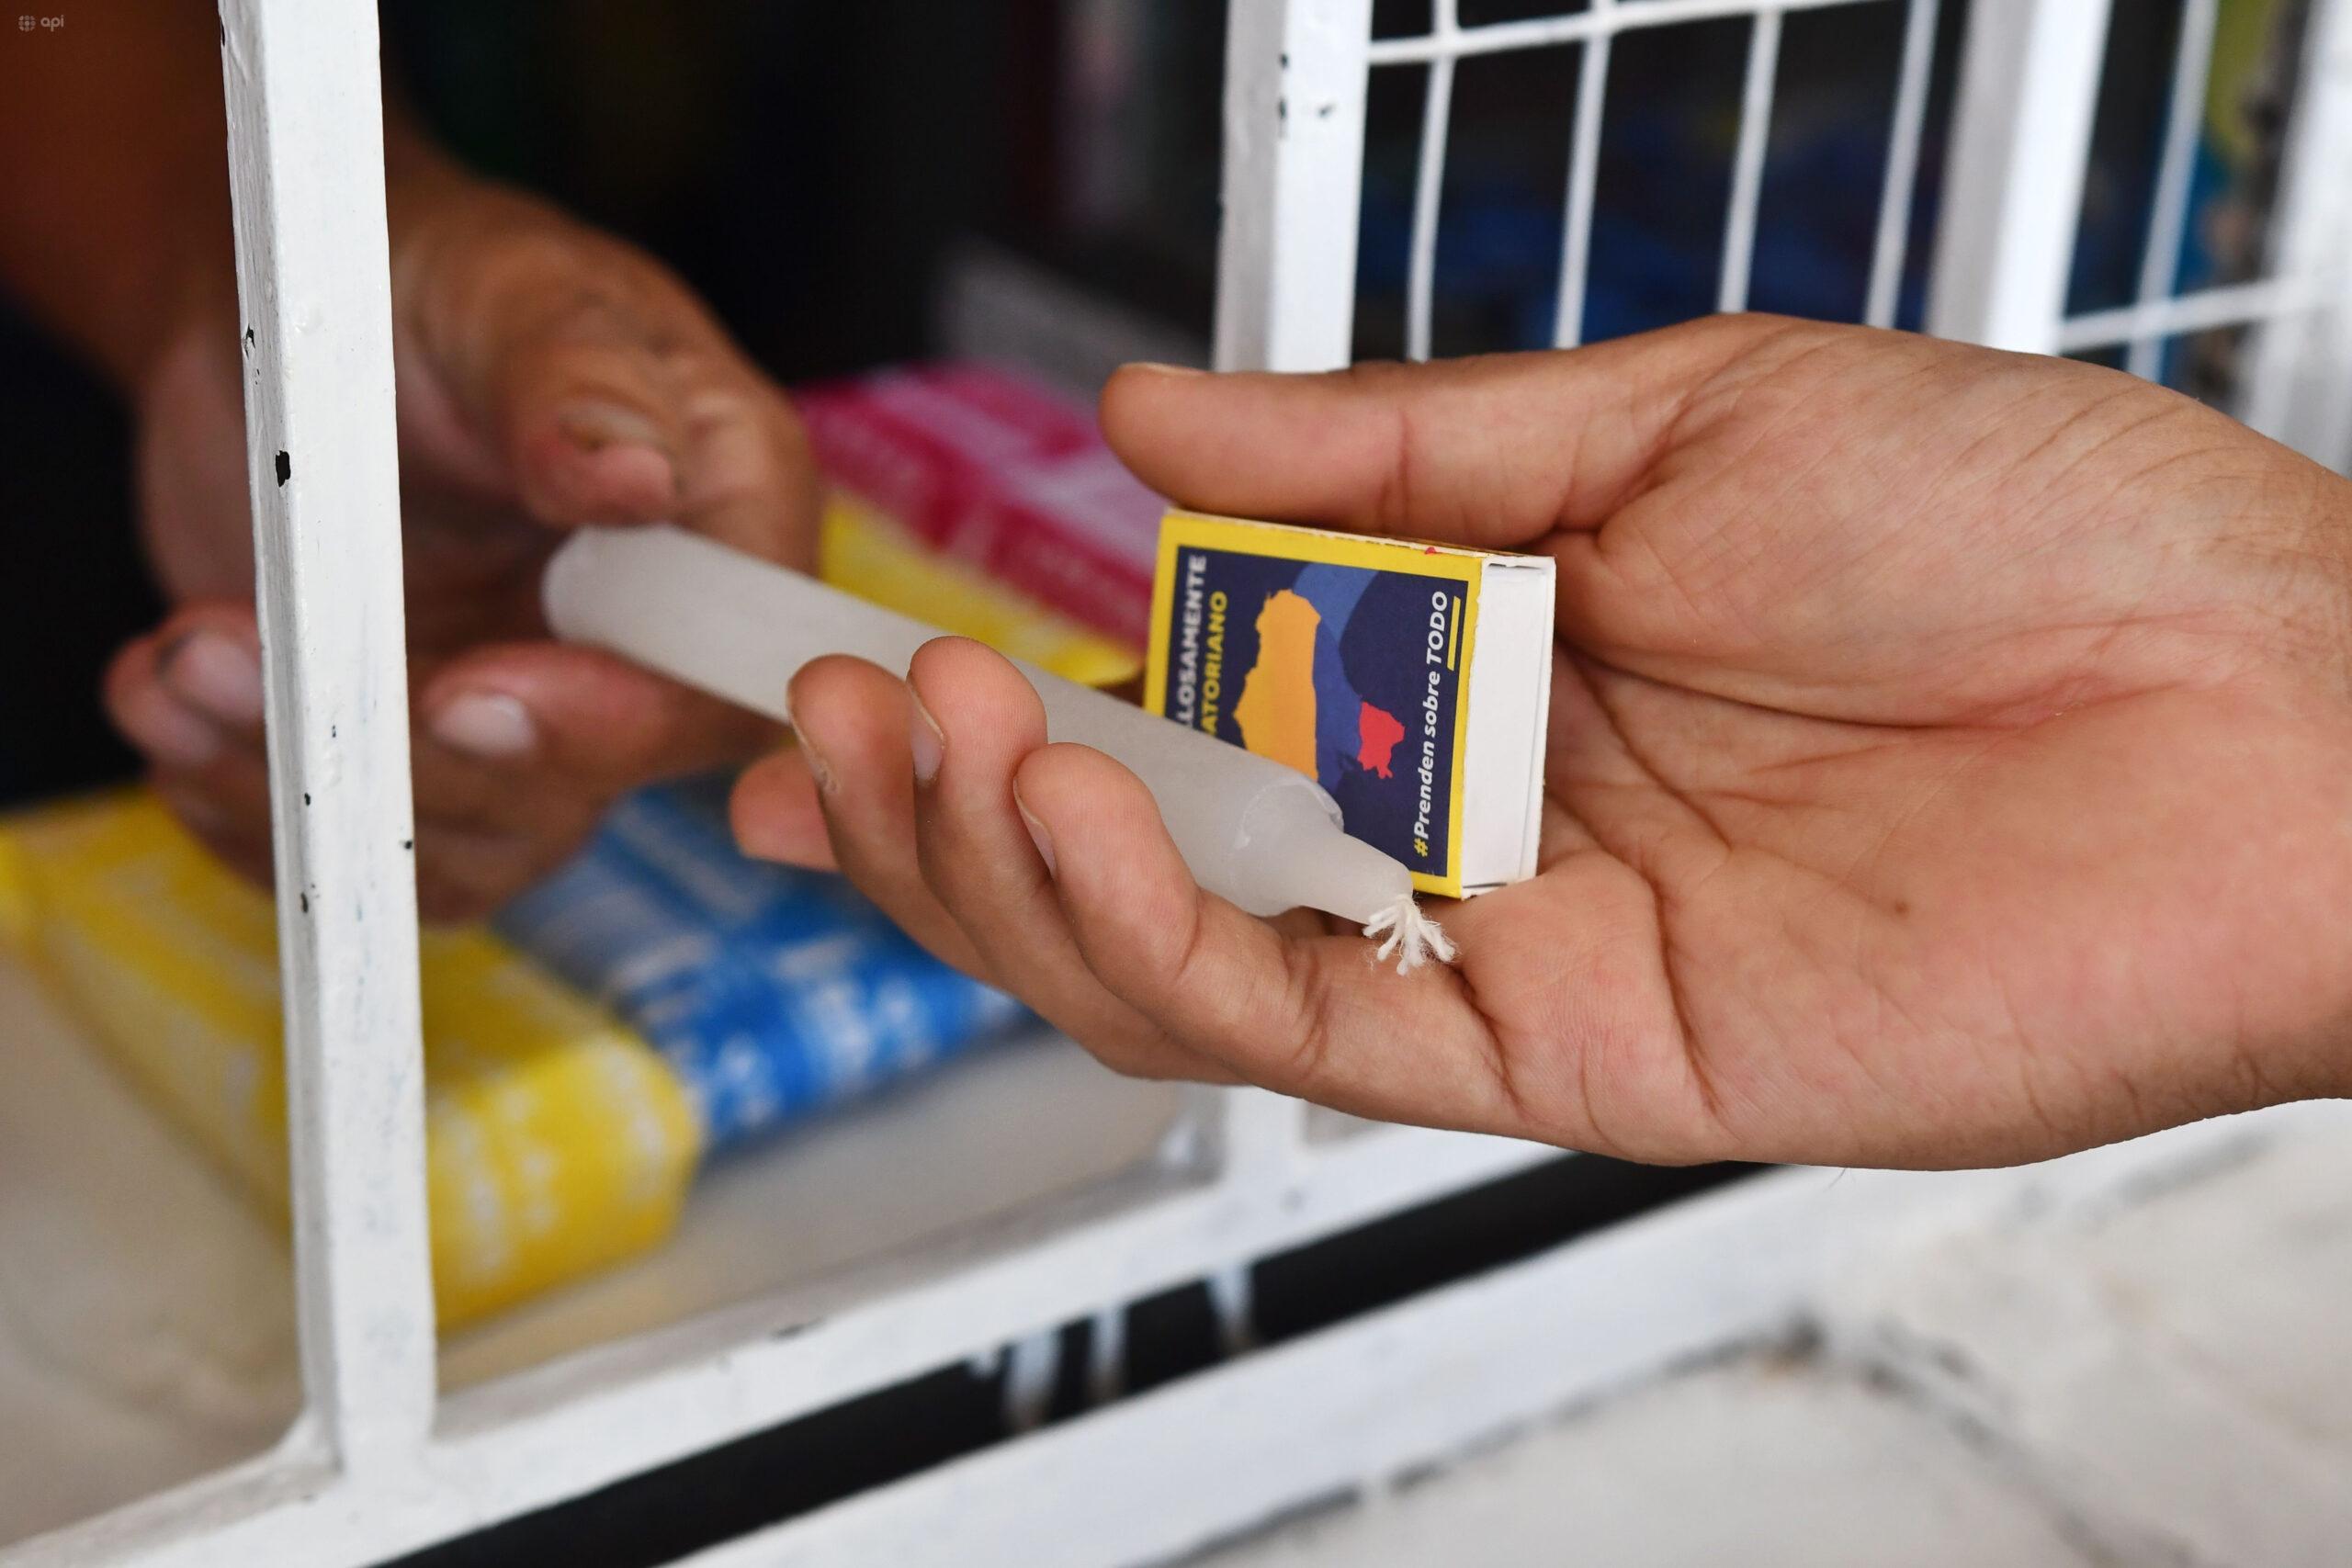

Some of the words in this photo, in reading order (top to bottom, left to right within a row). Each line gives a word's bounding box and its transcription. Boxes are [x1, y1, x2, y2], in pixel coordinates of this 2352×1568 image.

[1176, 555, 1207, 726] LOSAMENTE
[1200, 591, 1228, 735] ATORIANO
[1426, 590, 1448, 665] TODO
[1420, 671, 1441, 737] sobre
[1413, 741, 1434, 857] #Prenden
